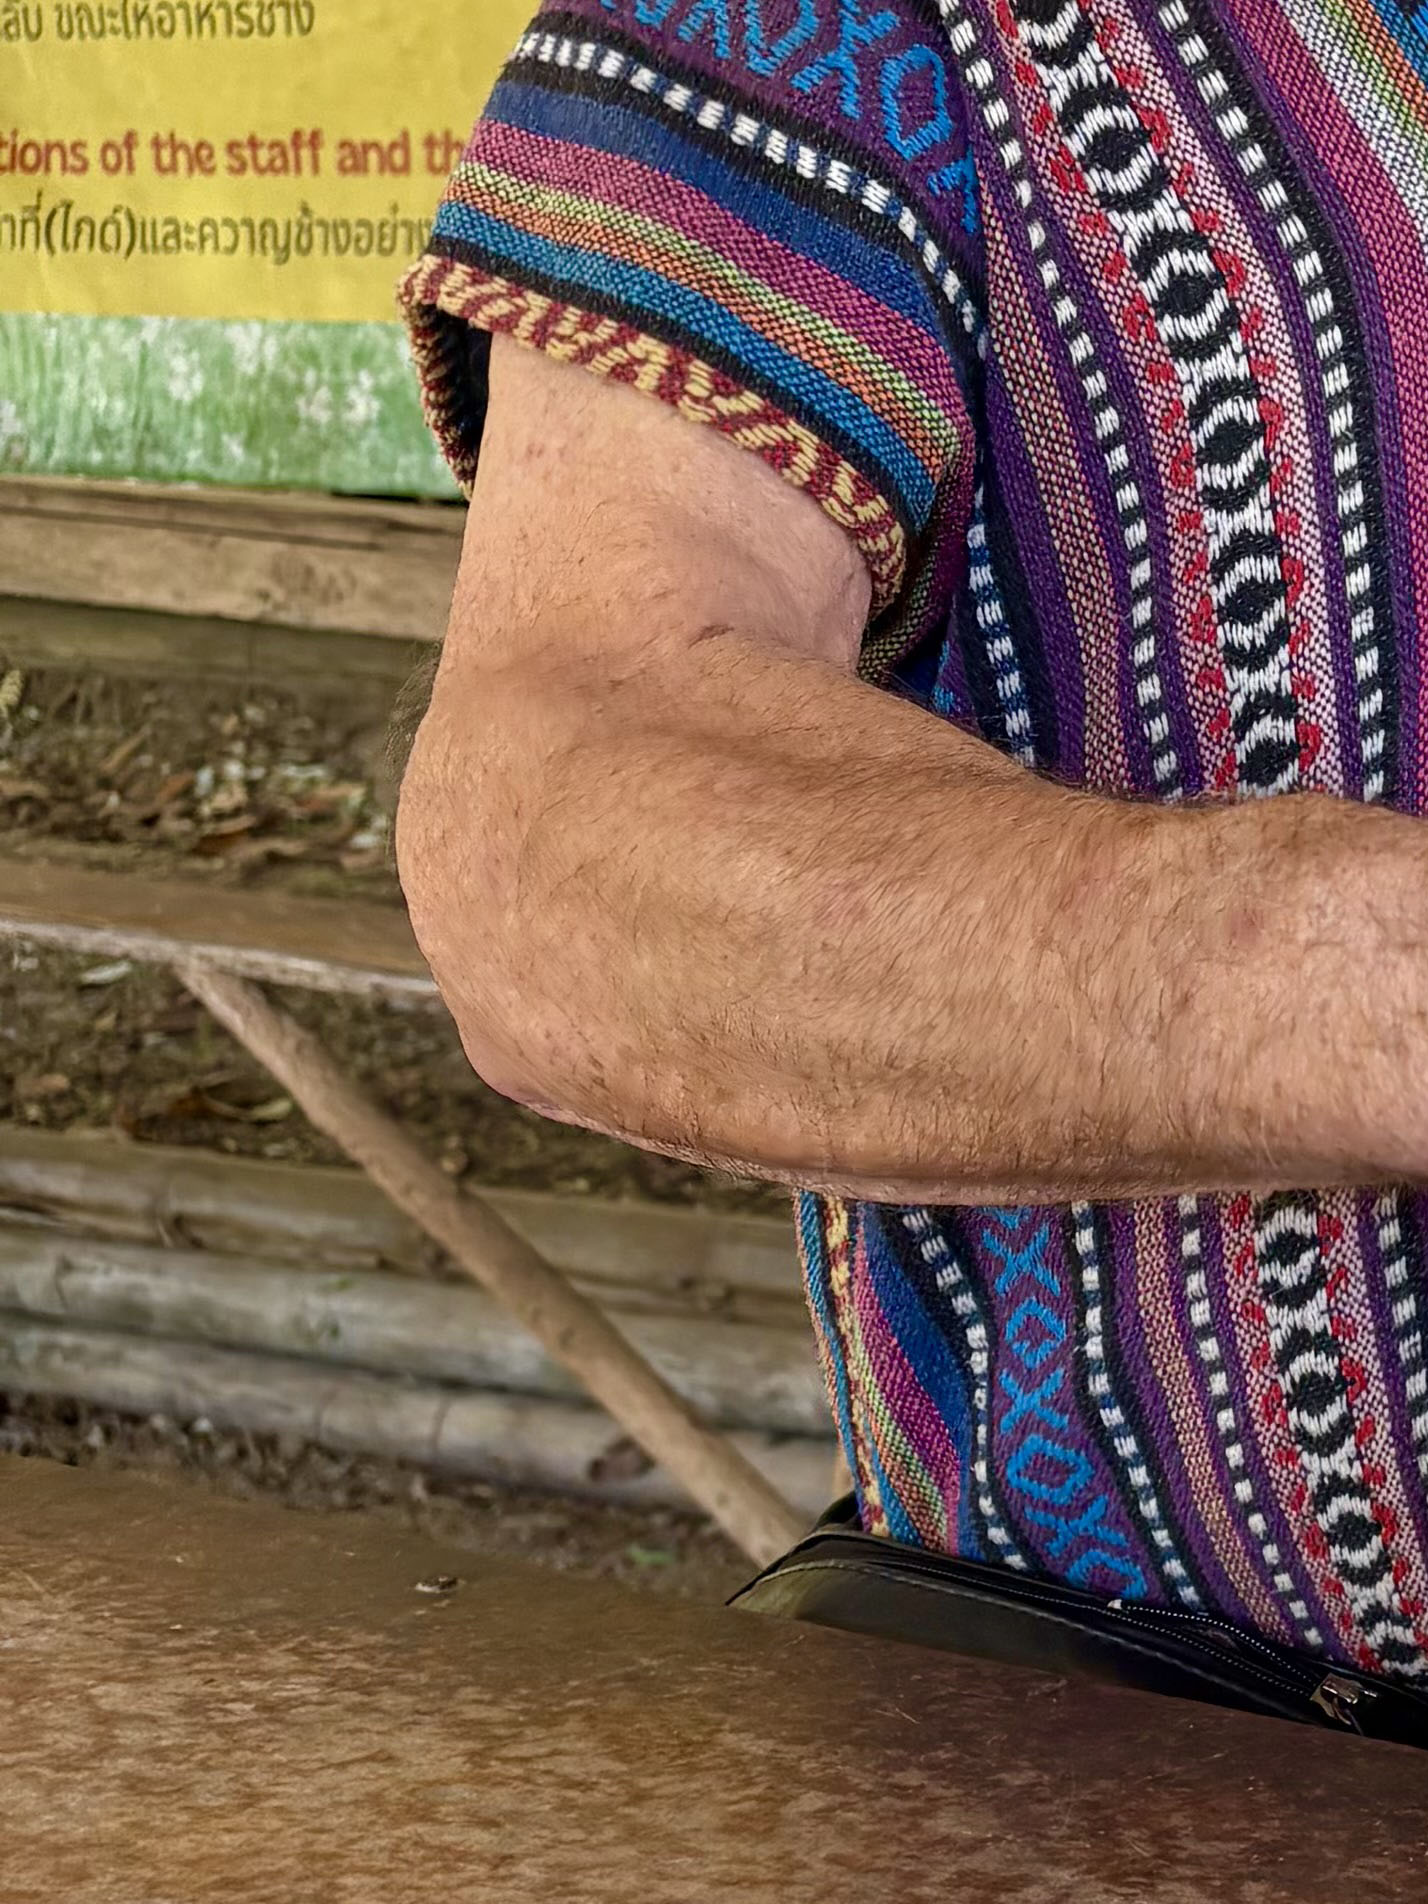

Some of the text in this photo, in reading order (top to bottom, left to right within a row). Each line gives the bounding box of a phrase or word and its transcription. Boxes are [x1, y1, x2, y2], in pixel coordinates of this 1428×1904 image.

[99, 128, 137, 177] of
[150, 129, 216, 177] the
[225, 127, 323, 176] staff
[336, 128, 411, 177] and
